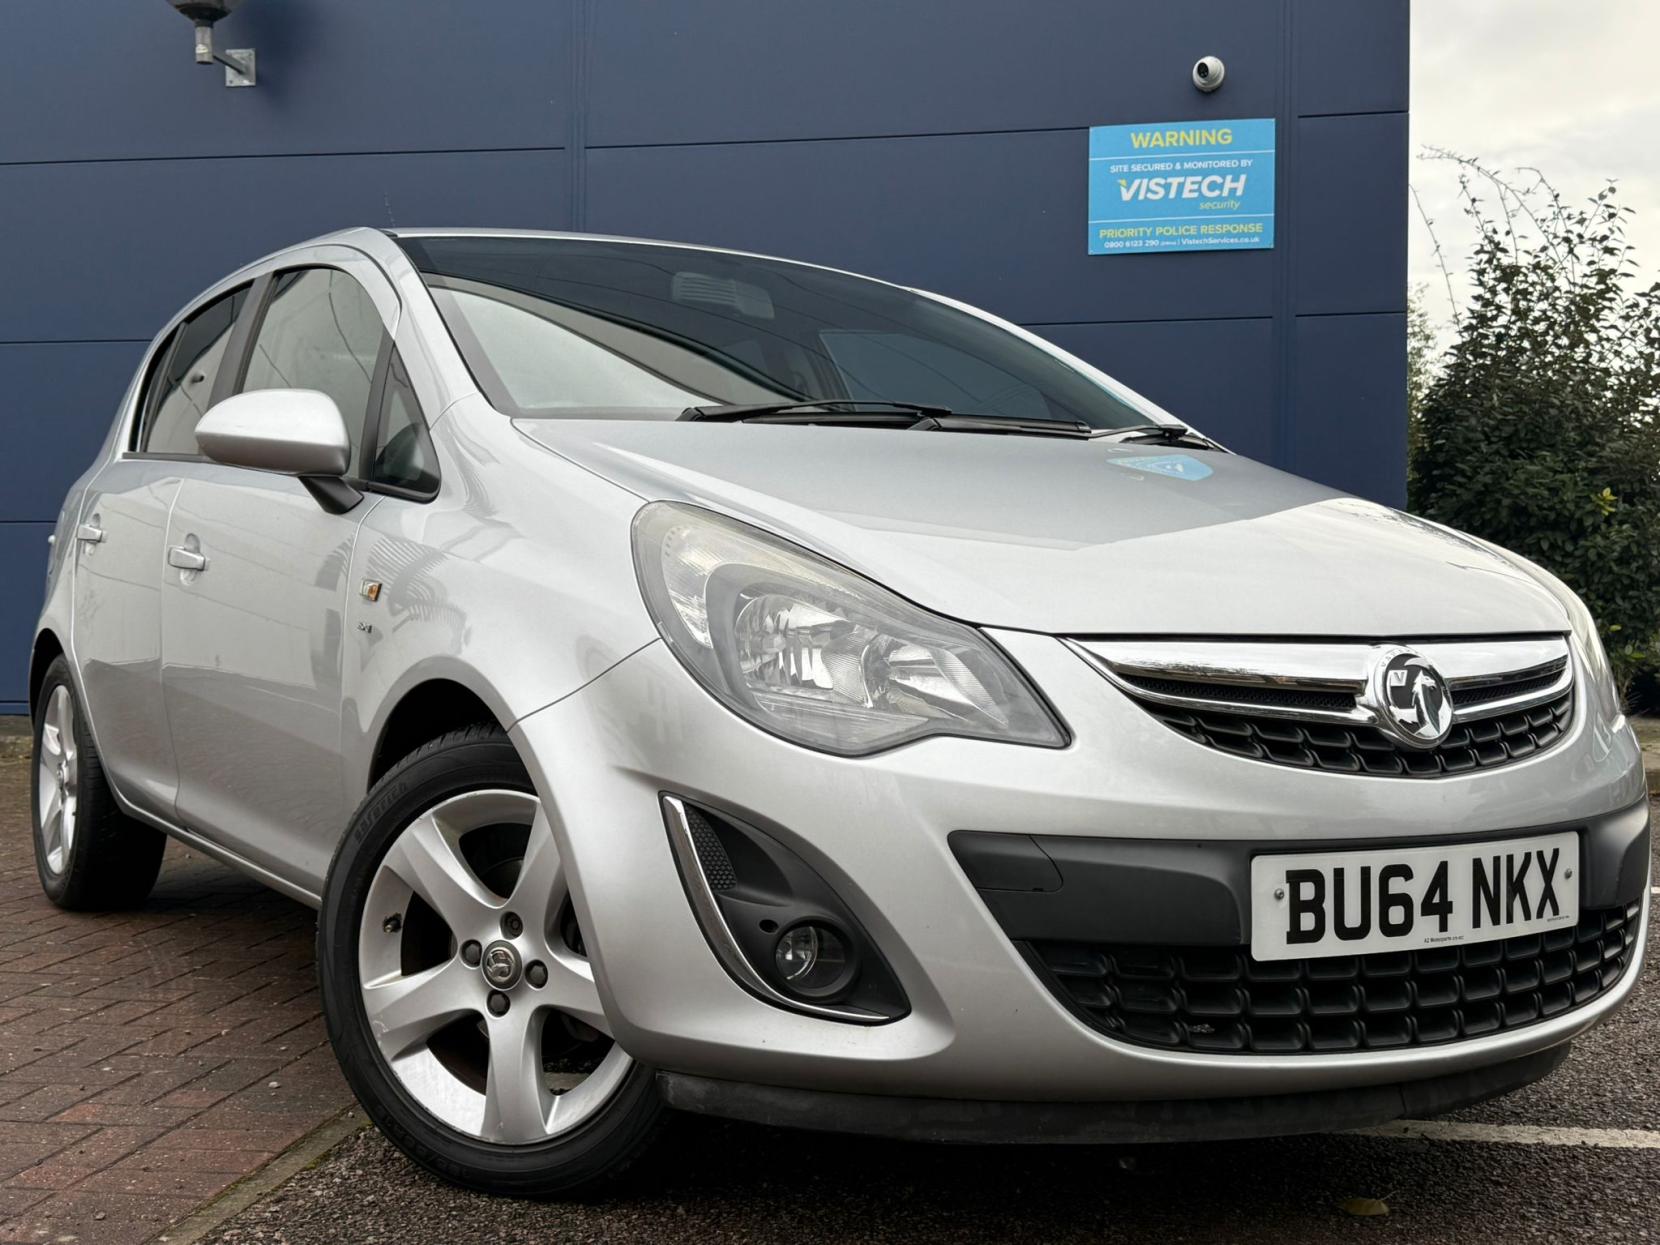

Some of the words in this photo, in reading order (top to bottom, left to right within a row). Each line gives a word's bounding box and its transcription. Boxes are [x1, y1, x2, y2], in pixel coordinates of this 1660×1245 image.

[1130, 128, 1233, 149] WARNING
[1110, 164, 1129, 174] SITE
[1131, 161, 1173, 173] SECURED
[1174, 161, 1182, 170] &
[1183, 159, 1239, 170] MONITORED
[1240, 158, 1254, 168] BY
[1117, 174, 1247, 201] VISTECH
[1199, 200, 1241, 211] security
[1099, 226, 1153, 239] PRIORITY
[1155, 225, 1197, 236] POLICE
[1200, 222, 1264, 235] RESPONSE
[1104, 240, 1124, 249] 0800
[1125, 239, 1143, 248] 6123
[1145, 239, 1160, 247] 290
[1181, 236, 1260, 245] VistechServices.co.uk
[1285, 860, 1454, 945] BU64
[1472, 847, 1560, 929] NKX
